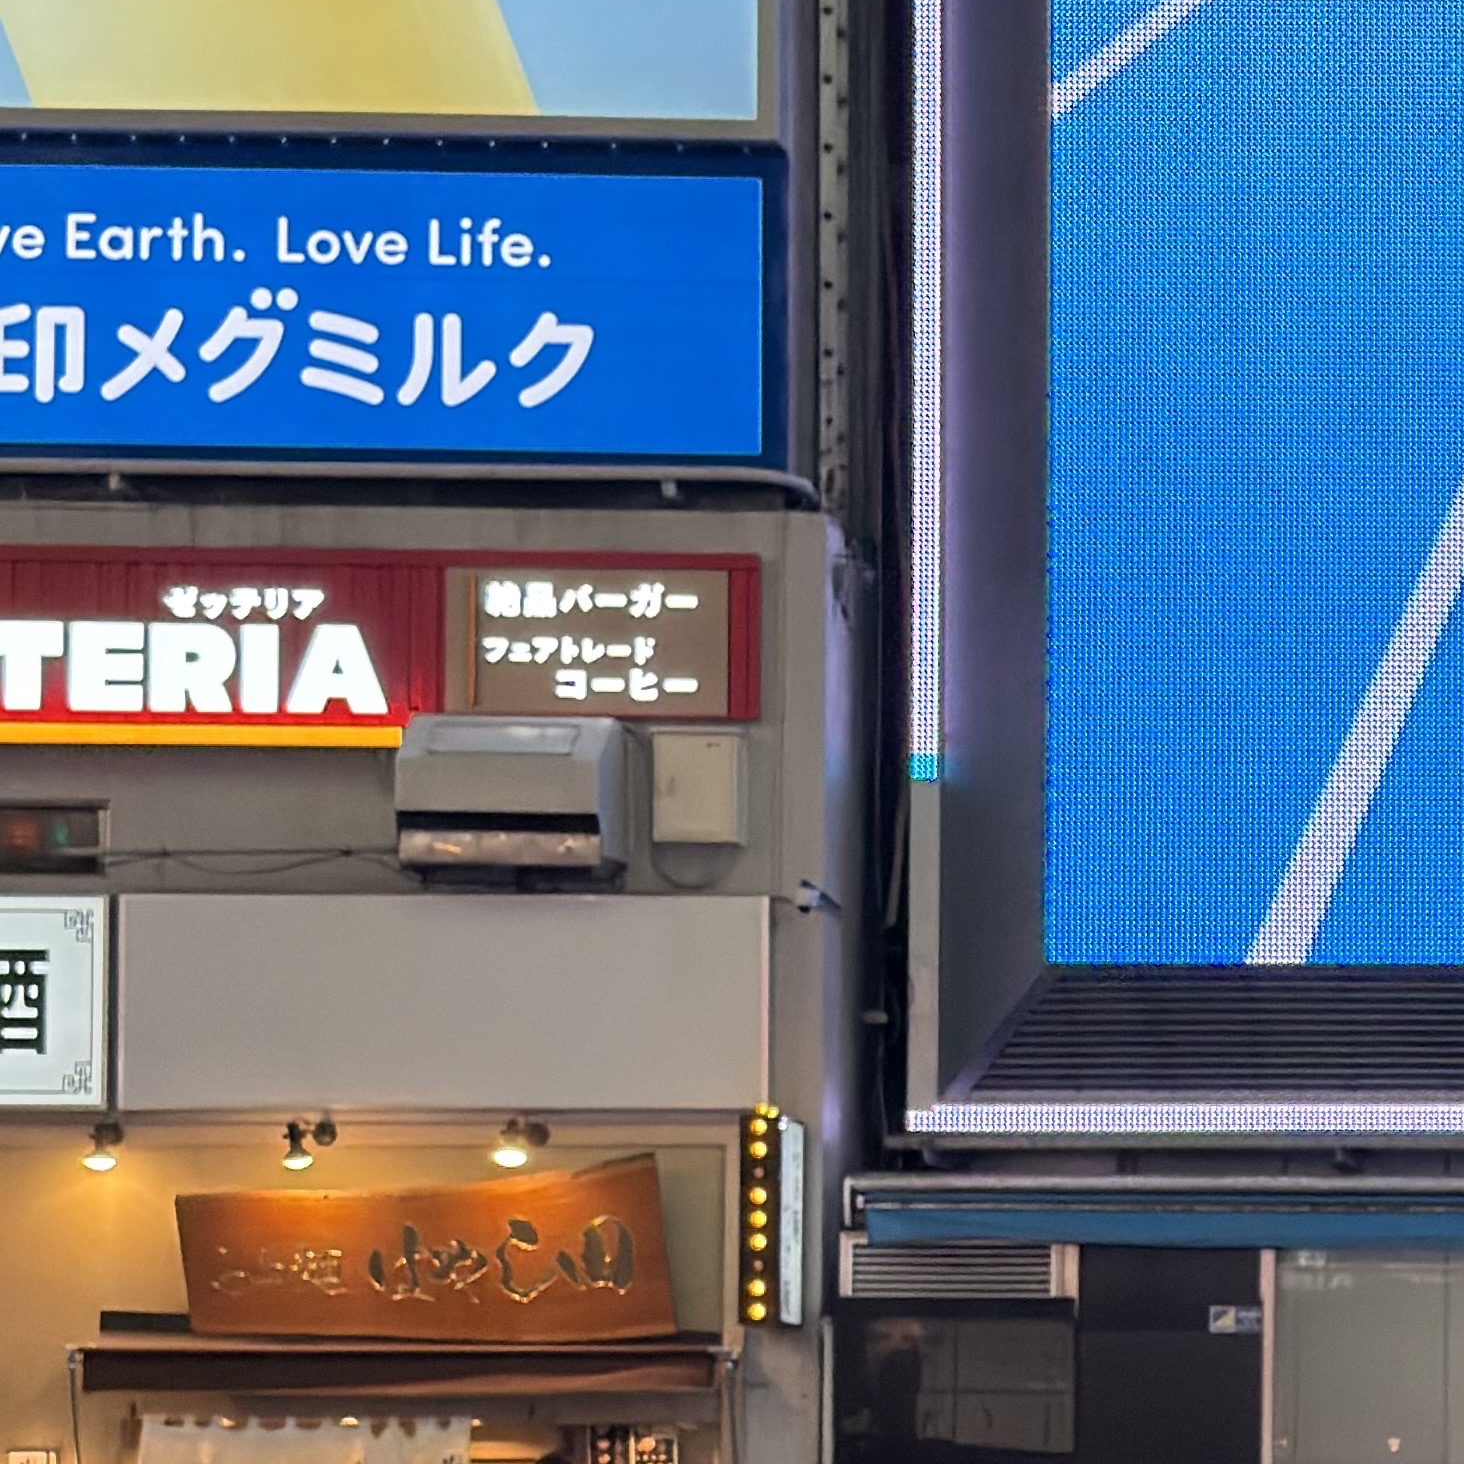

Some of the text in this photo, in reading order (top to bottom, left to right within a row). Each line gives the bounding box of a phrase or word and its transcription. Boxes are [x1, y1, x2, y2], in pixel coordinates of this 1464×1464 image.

[66, 212, 246, 261] Earth.
[277, 217, 408, 266] Love
[428, 217, 552, 269] Life.
[0, 287, 594, 408] 印メグミルク
[164, 587, 325, 620] ゼッテリア
[0, 620, 388, 714] TERIA
[482, 636, 656, 666] フェアトレード
[554, 668, 698, 701] コーヒー
